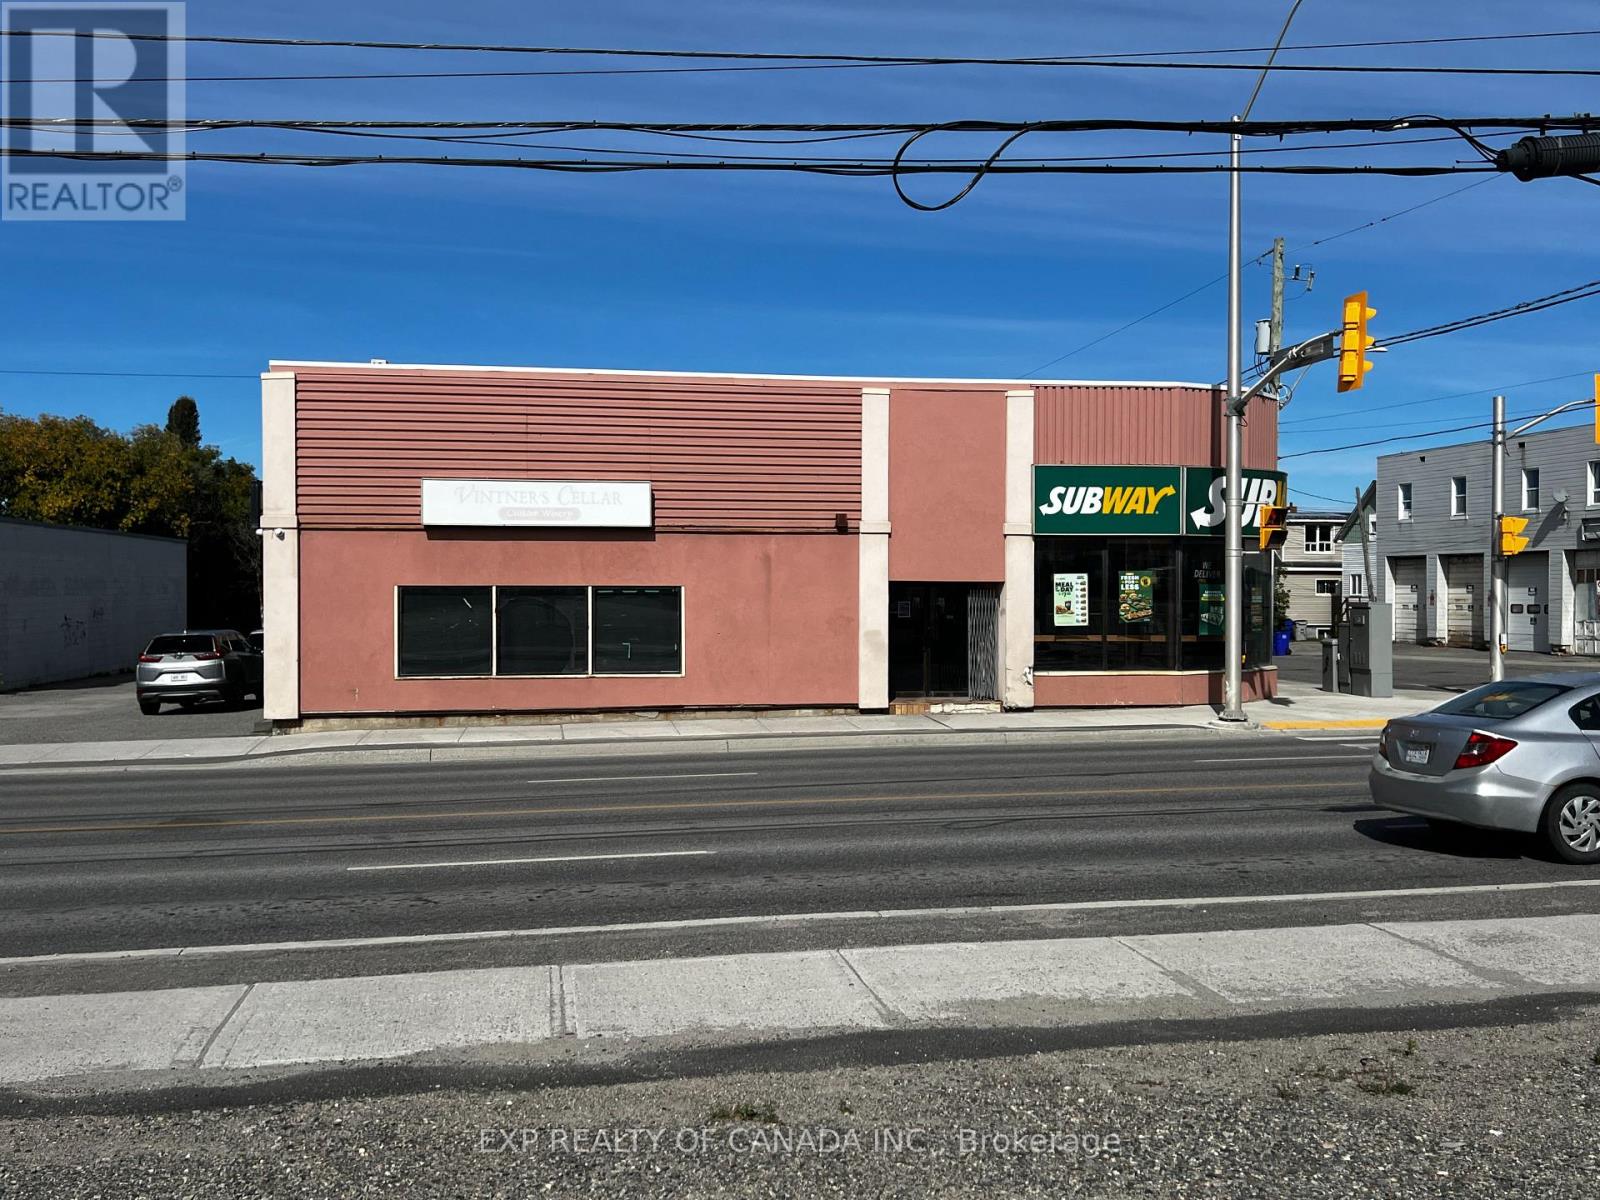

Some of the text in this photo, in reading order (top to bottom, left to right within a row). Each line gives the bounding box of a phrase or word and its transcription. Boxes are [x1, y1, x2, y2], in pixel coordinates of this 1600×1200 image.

[454, 484, 623, 505] VINTNER'S CELLAR
[1039, 484, 1177, 517] SUBWAY
